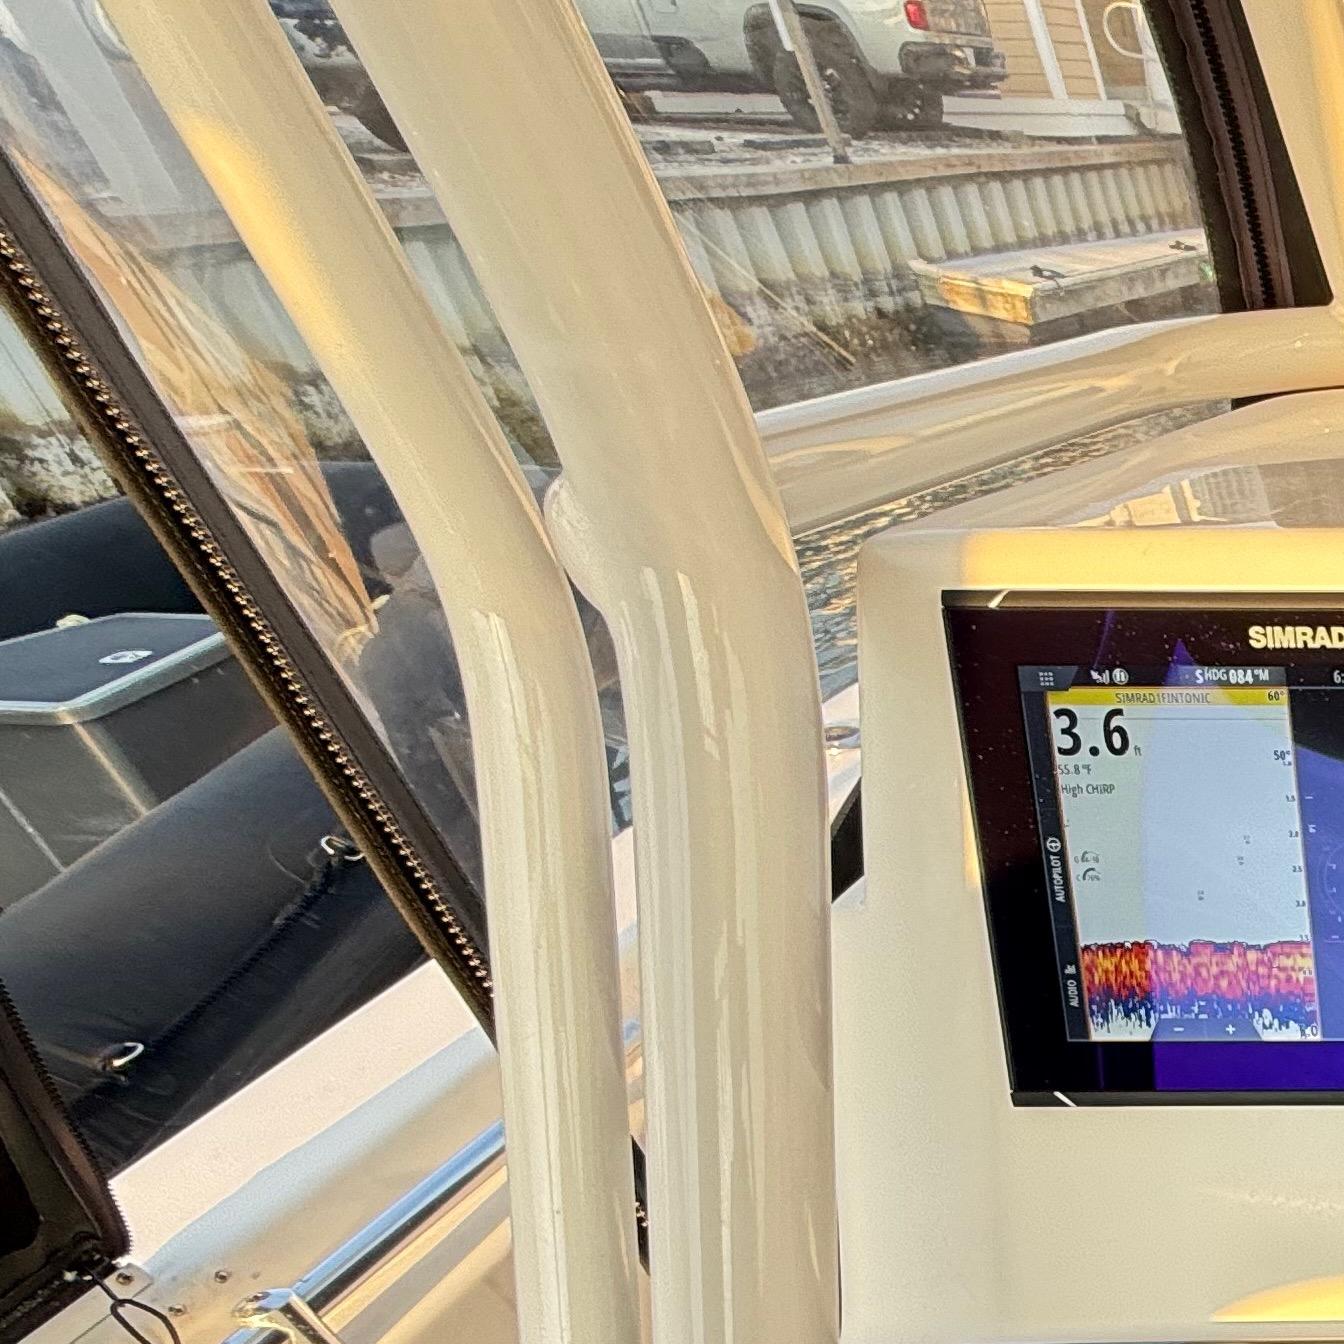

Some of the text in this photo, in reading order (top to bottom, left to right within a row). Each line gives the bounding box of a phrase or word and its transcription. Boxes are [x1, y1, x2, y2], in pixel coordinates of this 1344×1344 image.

[1204, 668, 1227, 680] HDG
[1268, 691, 1284, 700] 60°
[1053, 708, 1142, 756] 3.6 ft
[1274, 750, 1290, 760] 50°
[1062, 784, 1114, 798] High CHIRP
[1050, 855, 1066, 903] AUTOPILOT
[1067, 980, 1079, 1007] AUDIO
